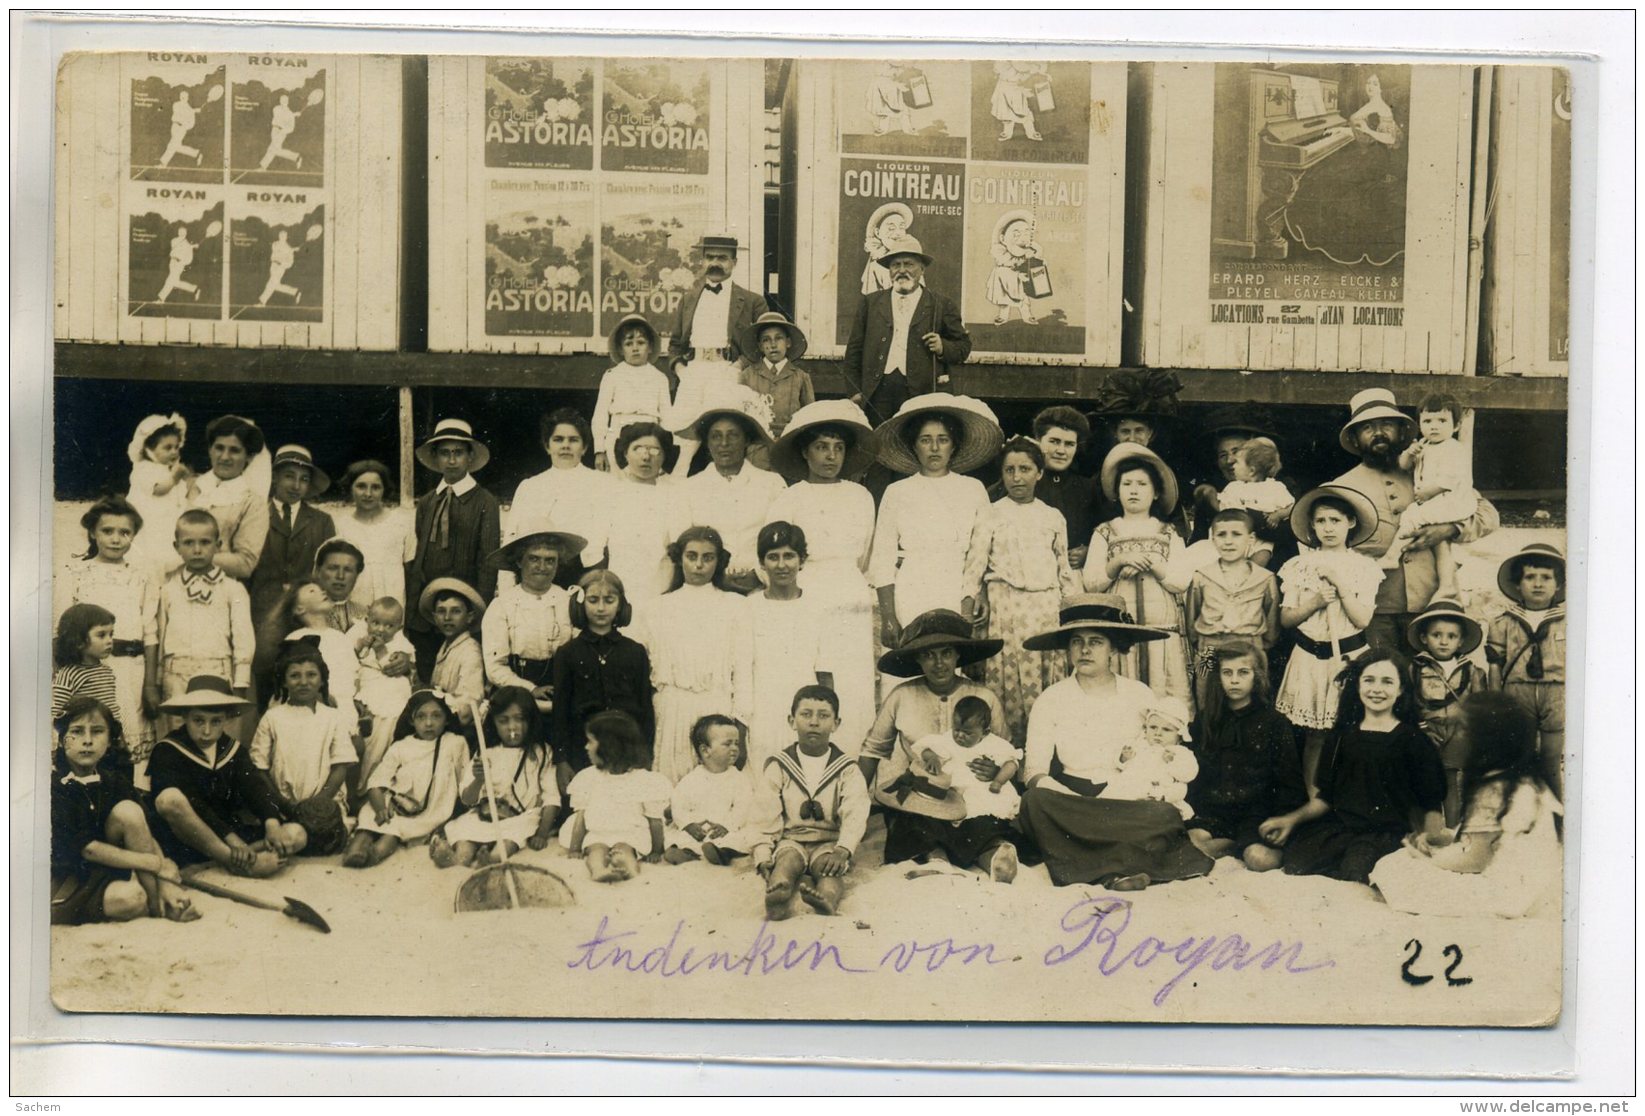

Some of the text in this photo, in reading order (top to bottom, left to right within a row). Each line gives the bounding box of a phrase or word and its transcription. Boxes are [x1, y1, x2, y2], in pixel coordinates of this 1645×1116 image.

[147, 52, 208, 64] ROYAN
[248, 55, 308, 68] ROYAN
[485, 121, 593, 146] ASTORIA
[602, 124, 709, 150] ASTORIA
[876, 163, 930, 172] LIQUEUR
[146, 188, 206, 200] ROYAN
[844, 170, 960, 201] COINTREAU
[969, 176, 1084, 207] COINTREAU
[247, 192, 307, 203] ROYAN
[1213, 273, 1265, 284] ERARD
[1284, 274, 1320, 286] HERZ
[1391, 277, 1400, 287] &
[486, 289, 593, 313] ASTORIA
[601, 291, 683, 313] ASTOR
[1227, 287, 1397, 300] PLEYEL GAVEAU KLEIN
[1211, 304, 1264, 323] LOCATIONS
[1280, 305, 1301, 313] 27
[1353, 306, 1405, 327] LOCATIONS
[1266, 315, 1315, 325] rue Gambetta
[880, 937, 1010, 972] von
[1044, 896, 1336, 1006] Royan
[1402, 938, 1473, 986] 22
